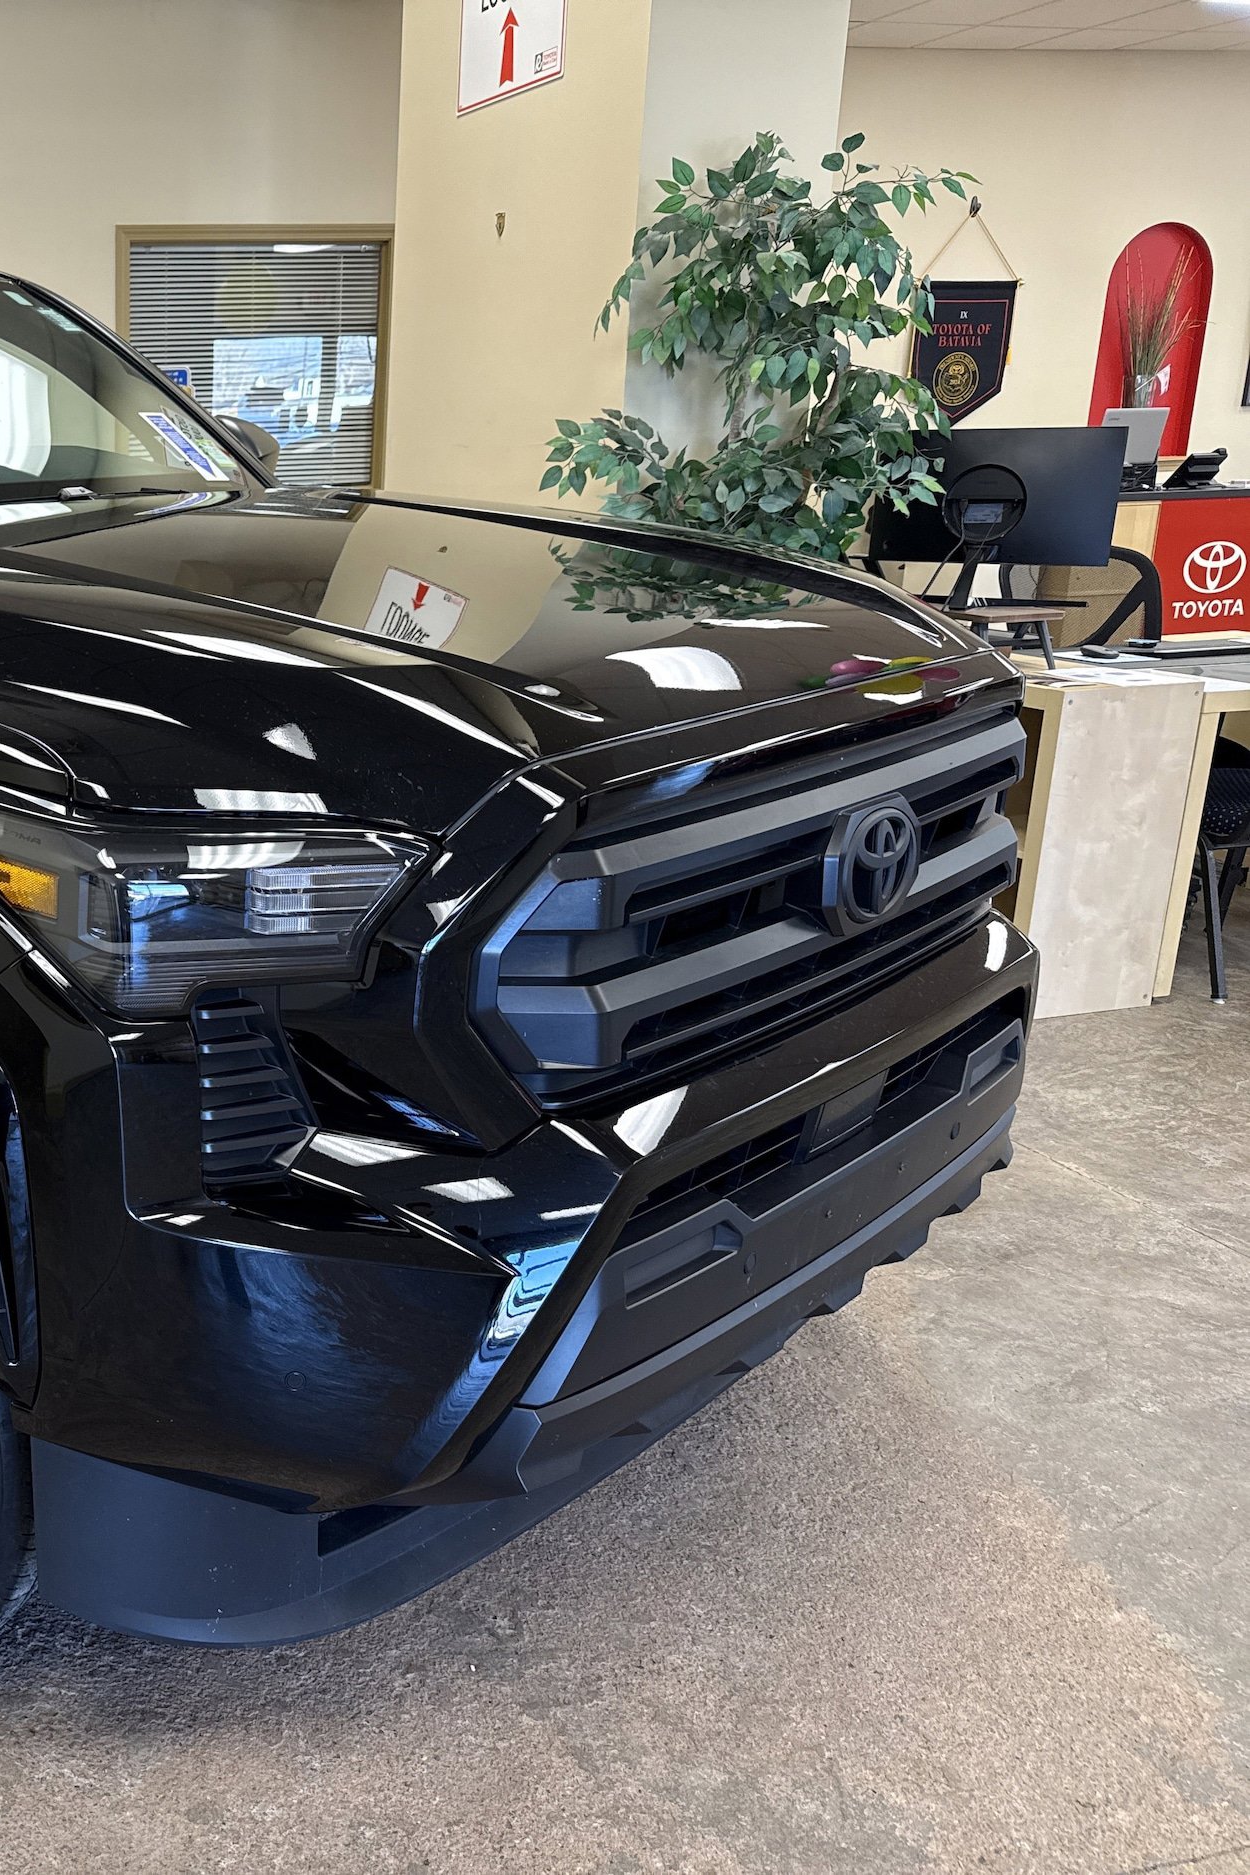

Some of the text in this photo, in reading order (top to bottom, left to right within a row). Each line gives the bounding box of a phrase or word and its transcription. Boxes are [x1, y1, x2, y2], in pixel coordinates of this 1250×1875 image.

[960, 311, 969, 319] IX
[932, 323, 992, 335] TOYOTA OF
[938, 335, 982, 347] BATAVIA
[1172, 598, 1245, 619] TOYOTA
